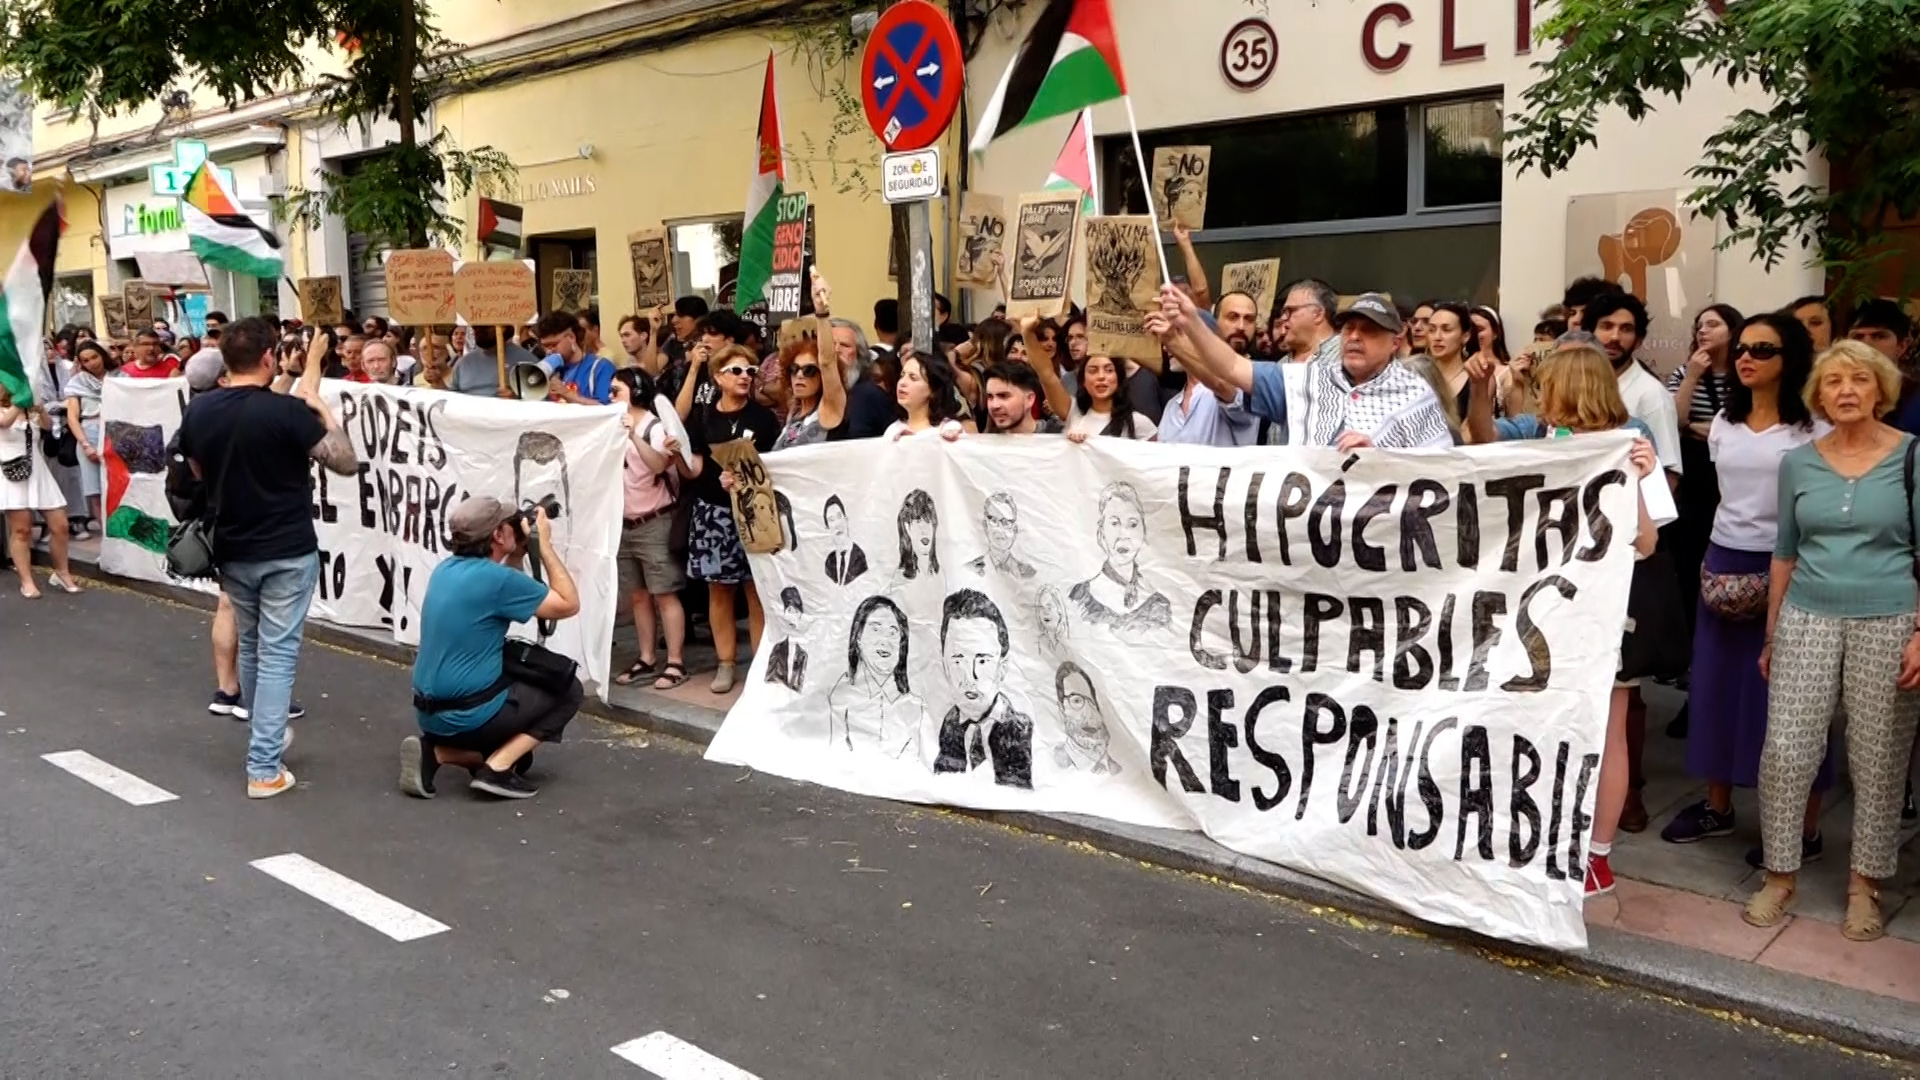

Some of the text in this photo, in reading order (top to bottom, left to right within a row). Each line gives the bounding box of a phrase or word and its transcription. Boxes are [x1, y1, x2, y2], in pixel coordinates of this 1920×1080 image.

[1232, 37, 1268, 72] 35
[1178, 153, 1205, 176] NO
[552, 174, 597, 198] NAILS
[888, 175, 934, 192] SEGURIDAD
[776, 195, 806, 223] STOP
[980, 215, 1004, 238] NO
[768, 288, 800, 312] LIBRE
[738, 457, 766, 487] NO
[1178, 453, 1628, 573] HIPÓCRITAS
[1188, 575, 1578, 692] CULPABLES
[1149, 684, 1600, 882] RESPONSABLE
